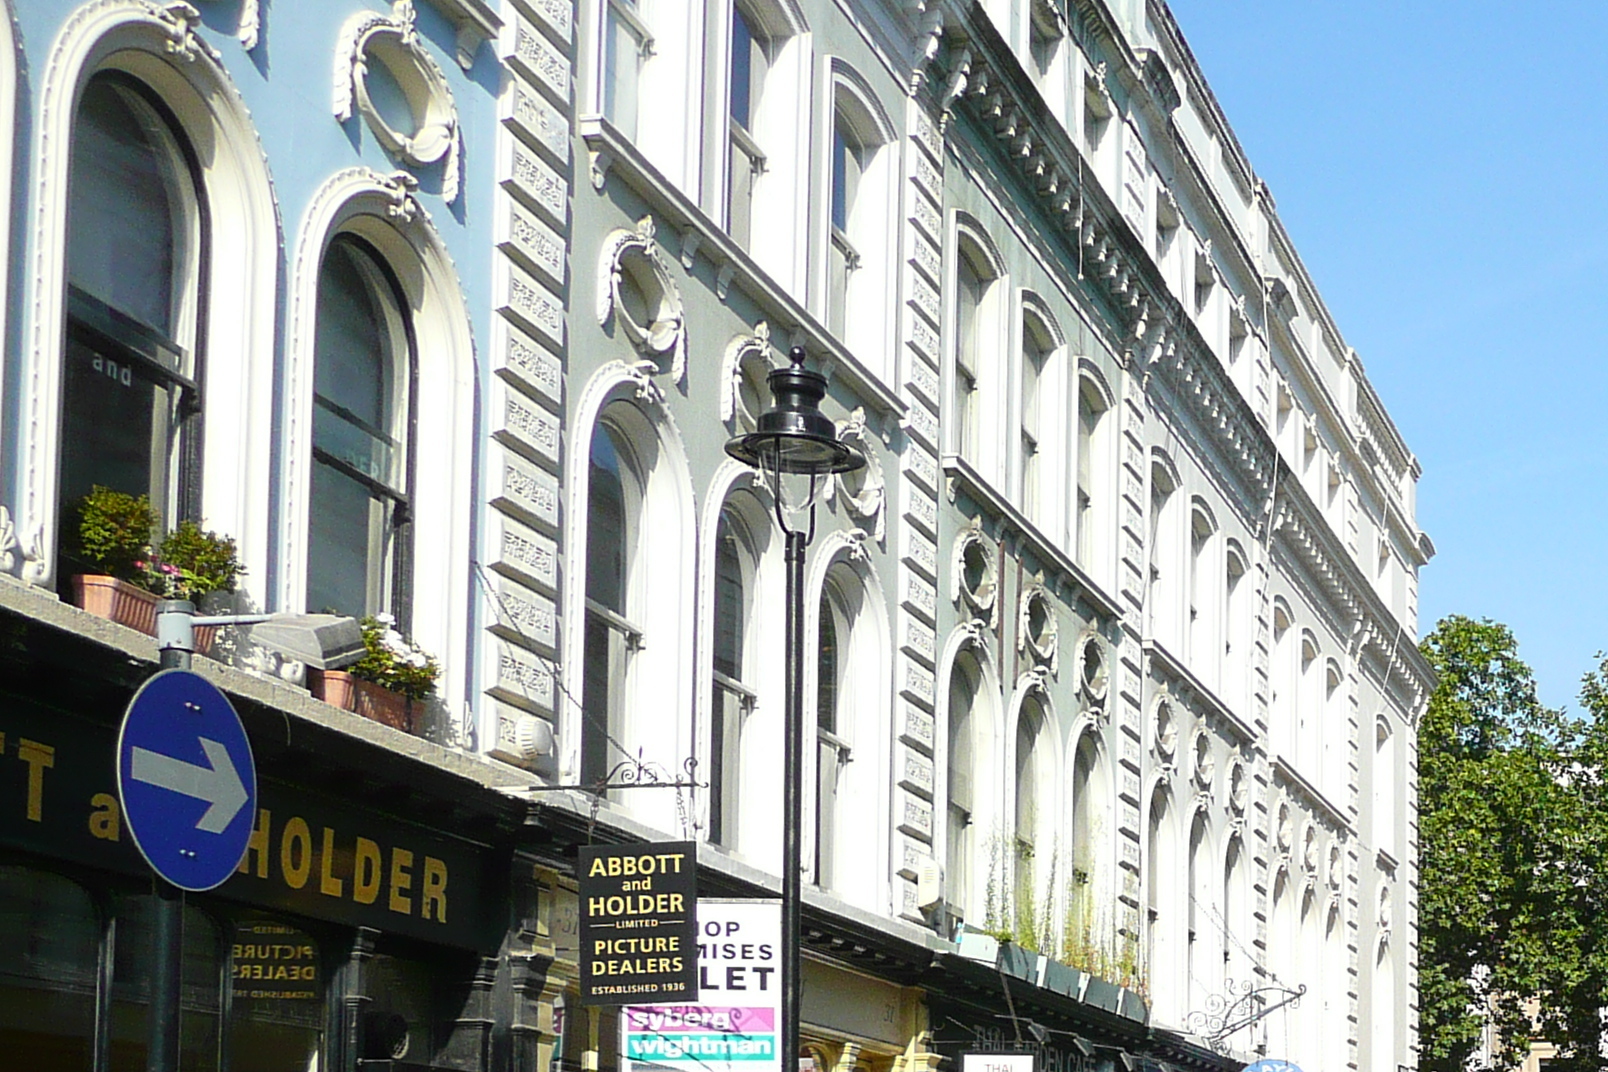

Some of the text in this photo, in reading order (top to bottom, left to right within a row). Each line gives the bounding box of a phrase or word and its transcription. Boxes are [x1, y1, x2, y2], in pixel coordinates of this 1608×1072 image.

[92, 353, 132, 387] and
[0, 732, 54, 822] T
[239, 808, 448, 924] HOLDER
[589, 853, 685, 877] ABBOTT
[621, 876, 652, 891] and
[589, 893, 685, 917] HOLDER
[615, 919, 659, 929] LIMITED
[697, 921, 741, 937] OP
[594, 937, 680, 955] PICTURE
[592, 957, 683, 976] DEALERS
[591, 982, 685, 995] ESTABLISHED 1936
[700, 967, 775, 991] LET
[631, 1008, 731, 1031] syberg
[631, 1036, 771, 1058] wightman
